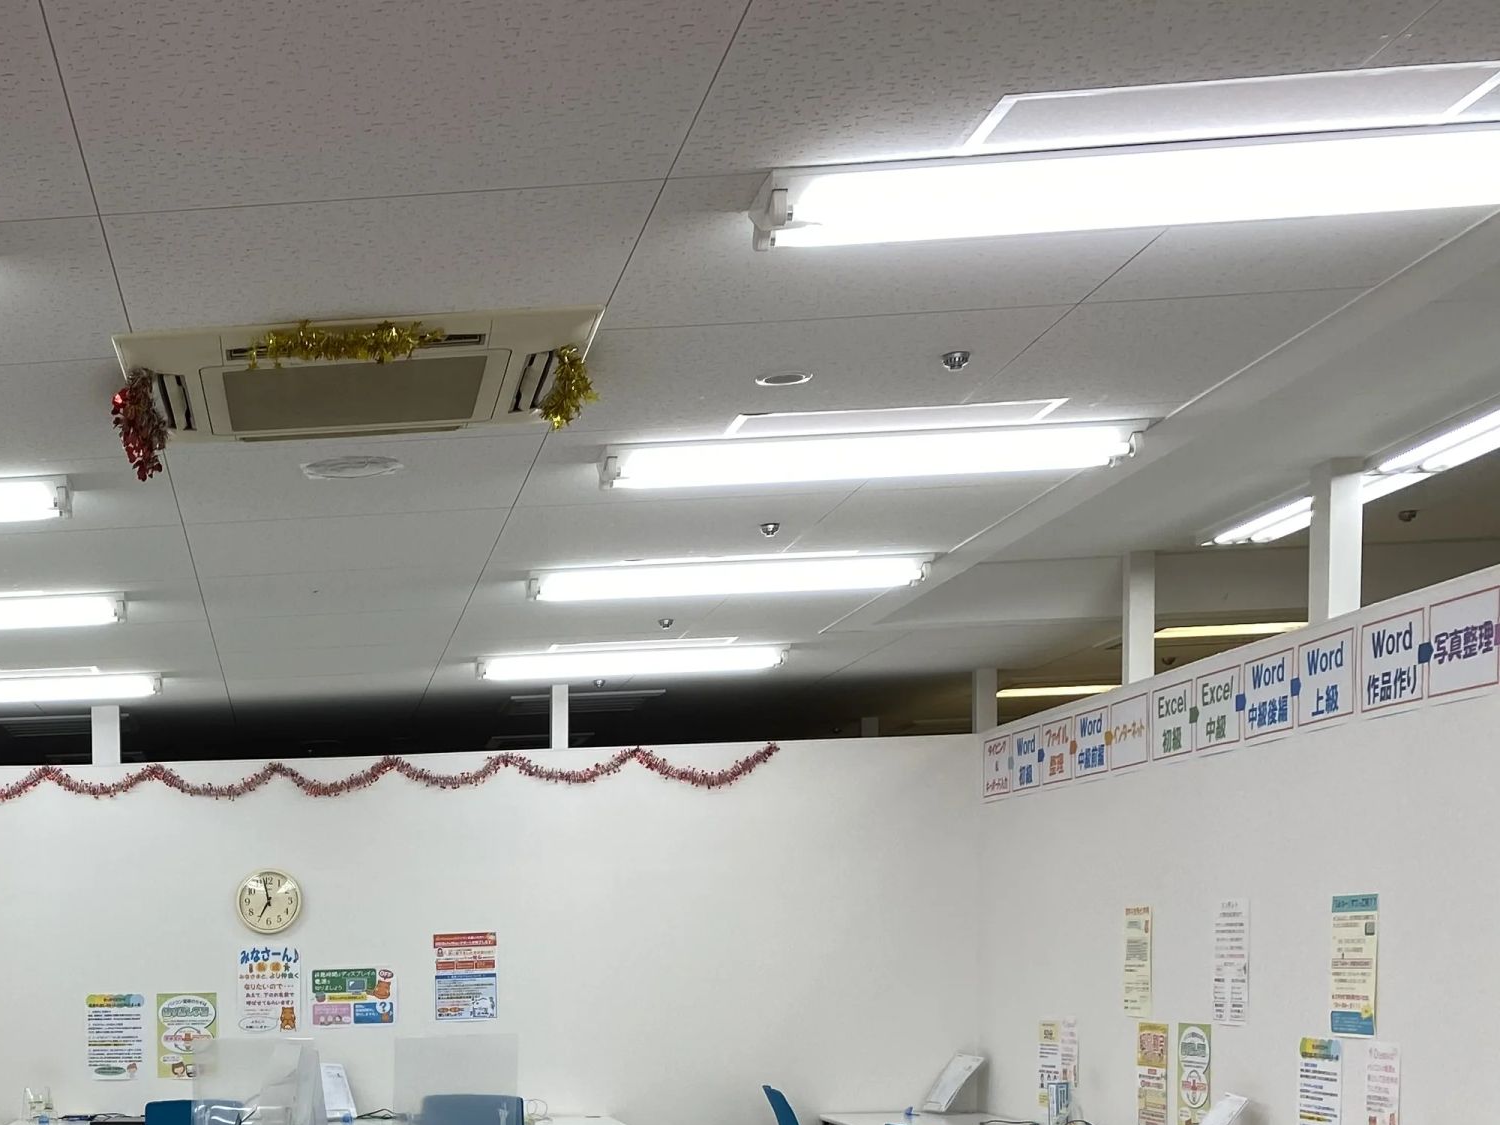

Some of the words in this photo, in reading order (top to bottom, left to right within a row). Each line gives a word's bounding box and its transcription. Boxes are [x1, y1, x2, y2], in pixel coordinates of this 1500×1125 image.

[1371, 621, 1413, 659] Word
[1433, 620, 1494, 664] 写真整理
[1252, 657, 1285, 690] Word
[1307, 641, 1344, 676] Word
[1201, 675, 1234, 706] Excel
[1311, 684, 1339, 716] 上級
[1366, 664, 1417, 705] 作品作り
[1158, 689, 1187, 719] Excel
[1248, 695, 1288, 730] 中級後編
[1045, 724, 1069, 748] ファイル
[1080, 713, 1102, 738] Word
[1113, 718, 1145, 744] インターネット
[1162, 726, 1182, 753] 初級
[1206, 715, 1226, 743] 中級
[1016, 733, 1036, 756] Word
